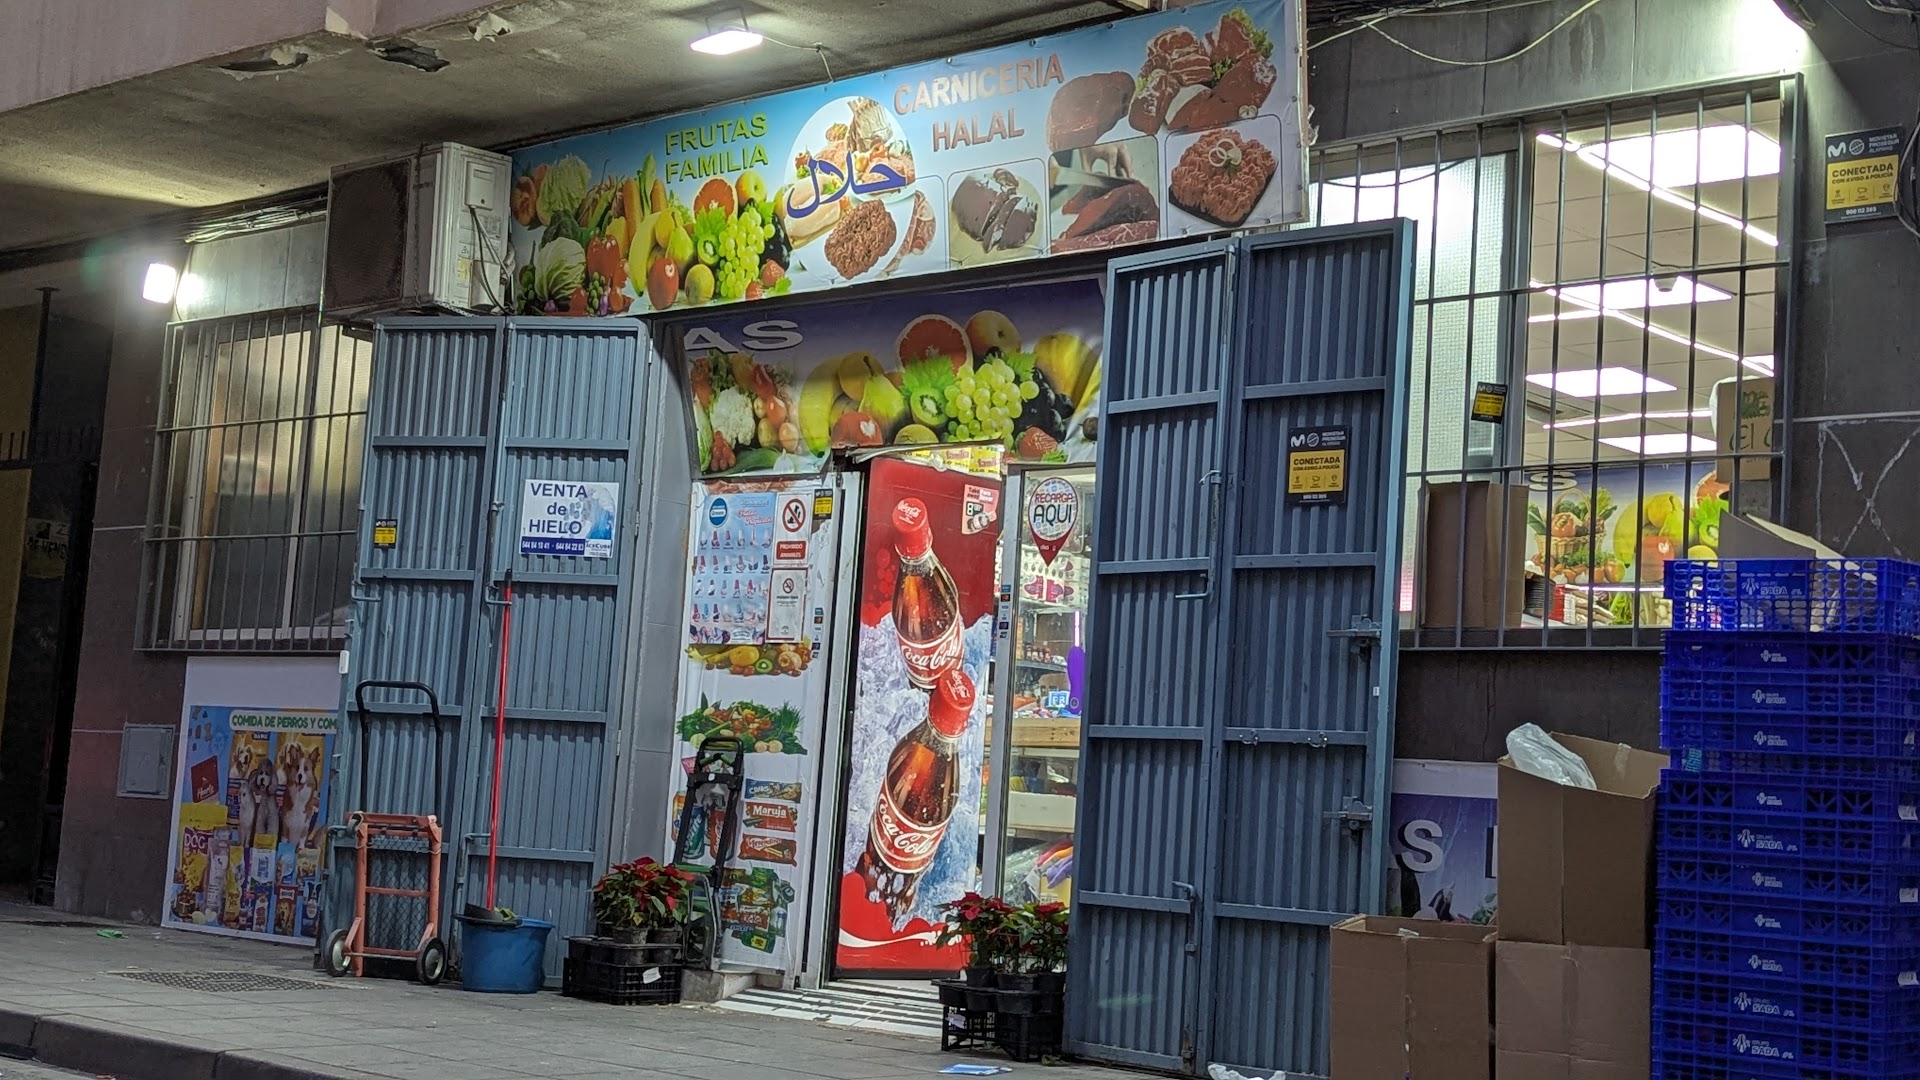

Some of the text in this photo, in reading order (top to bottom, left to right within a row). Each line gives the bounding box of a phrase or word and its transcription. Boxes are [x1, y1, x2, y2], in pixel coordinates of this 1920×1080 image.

[893, 52, 1064, 115] CARNICERIA
[665, 112, 768, 155] FRUTAS
[932, 108, 1025, 152] HALAL
[665, 144, 768, 183] FAMILIA
[1832, 162, 1894, 178] CONECTADA
[787, 151, 908, 218] حلال
[1293, 457, 1340, 465] CONECTADA
[530, 483, 588, 499] VENTA
[546, 502, 567, 516] de
[1033, 503, 1072, 527] AQUI
[529, 519, 582, 534] HIELO
[1760, 586, 1788, 595] SADA
[232, 714, 263, 727] COMIDA
[264, 716, 277, 728] DE
[277, 716, 309, 729] PERROS
[309, 717, 317, 729] Y
[752, 804, 787, 819] Maruja
[1401, 819, 1443, 873] S
[1756, 840, 1783, 850] SADA
[1753, 1005, 1780, 1015] SADA
[1752, 1046, 1780, 1057] SADA
